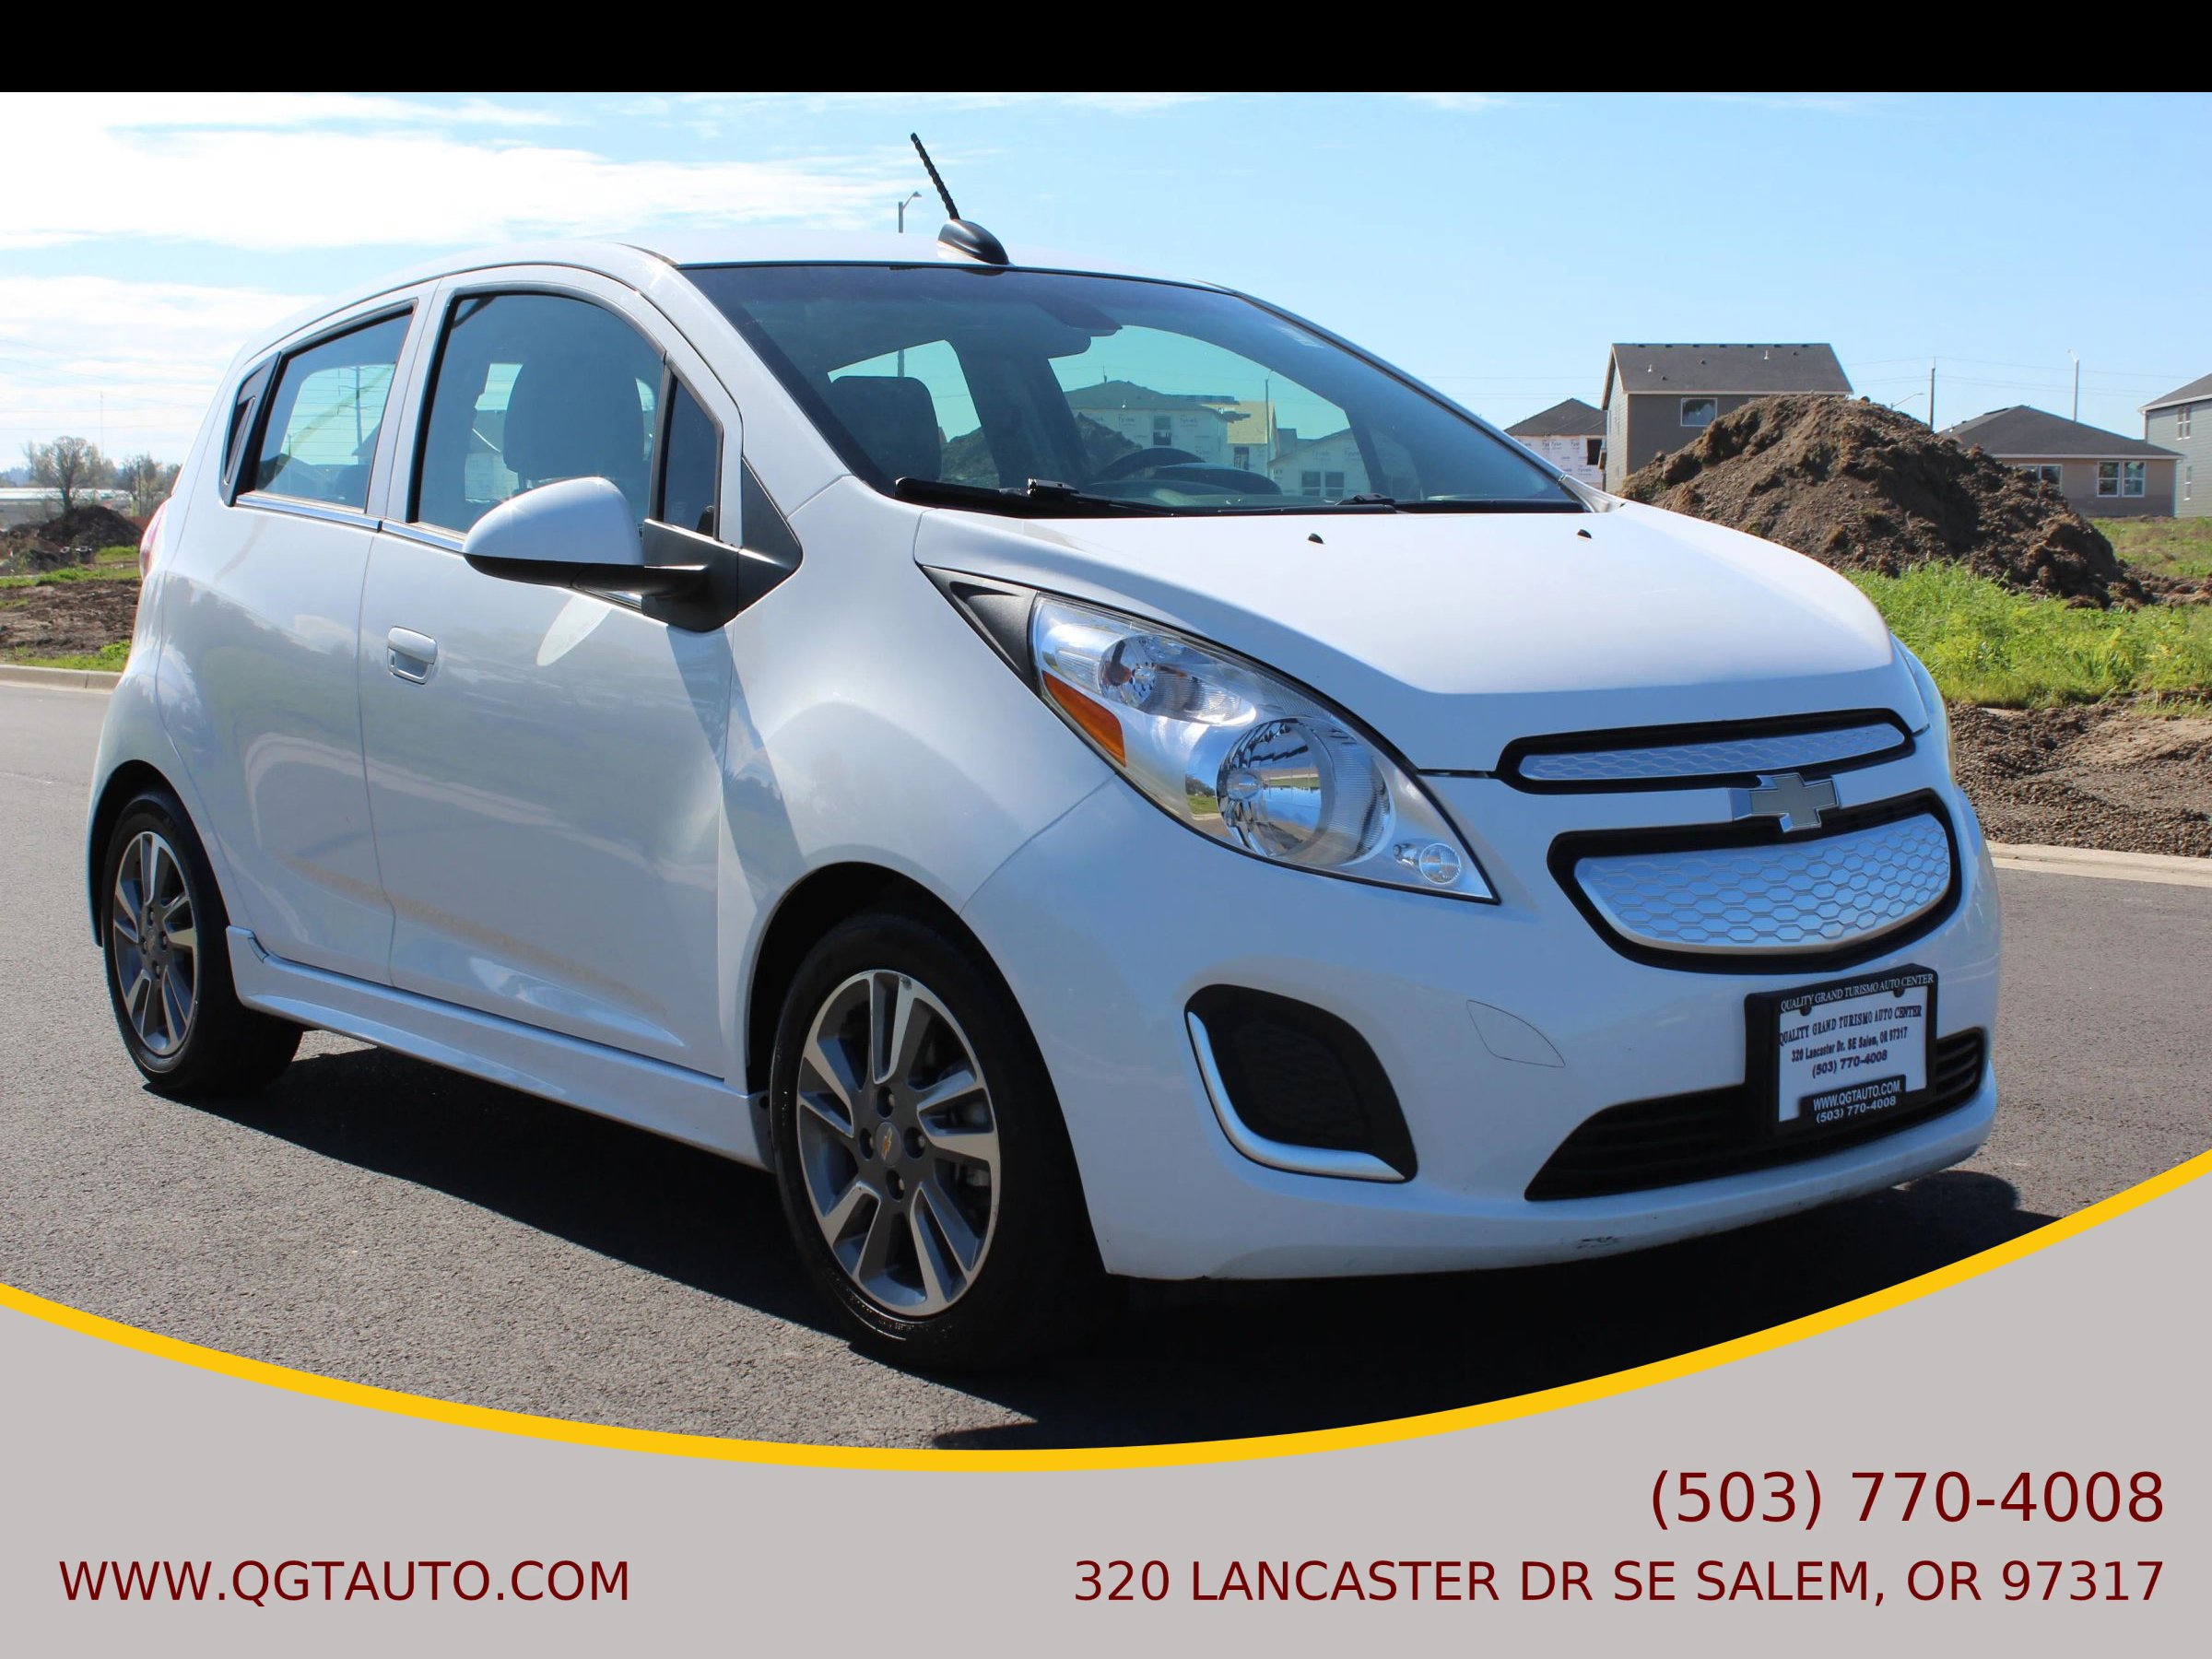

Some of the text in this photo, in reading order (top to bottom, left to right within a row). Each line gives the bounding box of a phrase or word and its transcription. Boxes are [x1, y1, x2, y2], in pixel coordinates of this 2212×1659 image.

[1781, 974, 1934, 1012] QUALITY GRAND TURISMO AUTO CENTER
[1780, 1006, 1922, 1046] QUALITY GRAND TURISMO AUTO CENTER
[1792, 1049, 1804, 1062] 320
[1806, 1043, 1835, 1059] Lancaster
[1837, 1041, 1845, 1053] Dr.
[1848, 1038, 1856, 1051] SE
[1880, 1030, 1888, 1043] OR
[1889, 1027, 1908, 1041] 97317
[1812, 1050, 1888, 1078] (503) 770-4008
[1813, 1080, 1900, 1111] WWW.QGTAUTO.COM
[1817, 1096, 1896, 1124] (503) 770-4008
